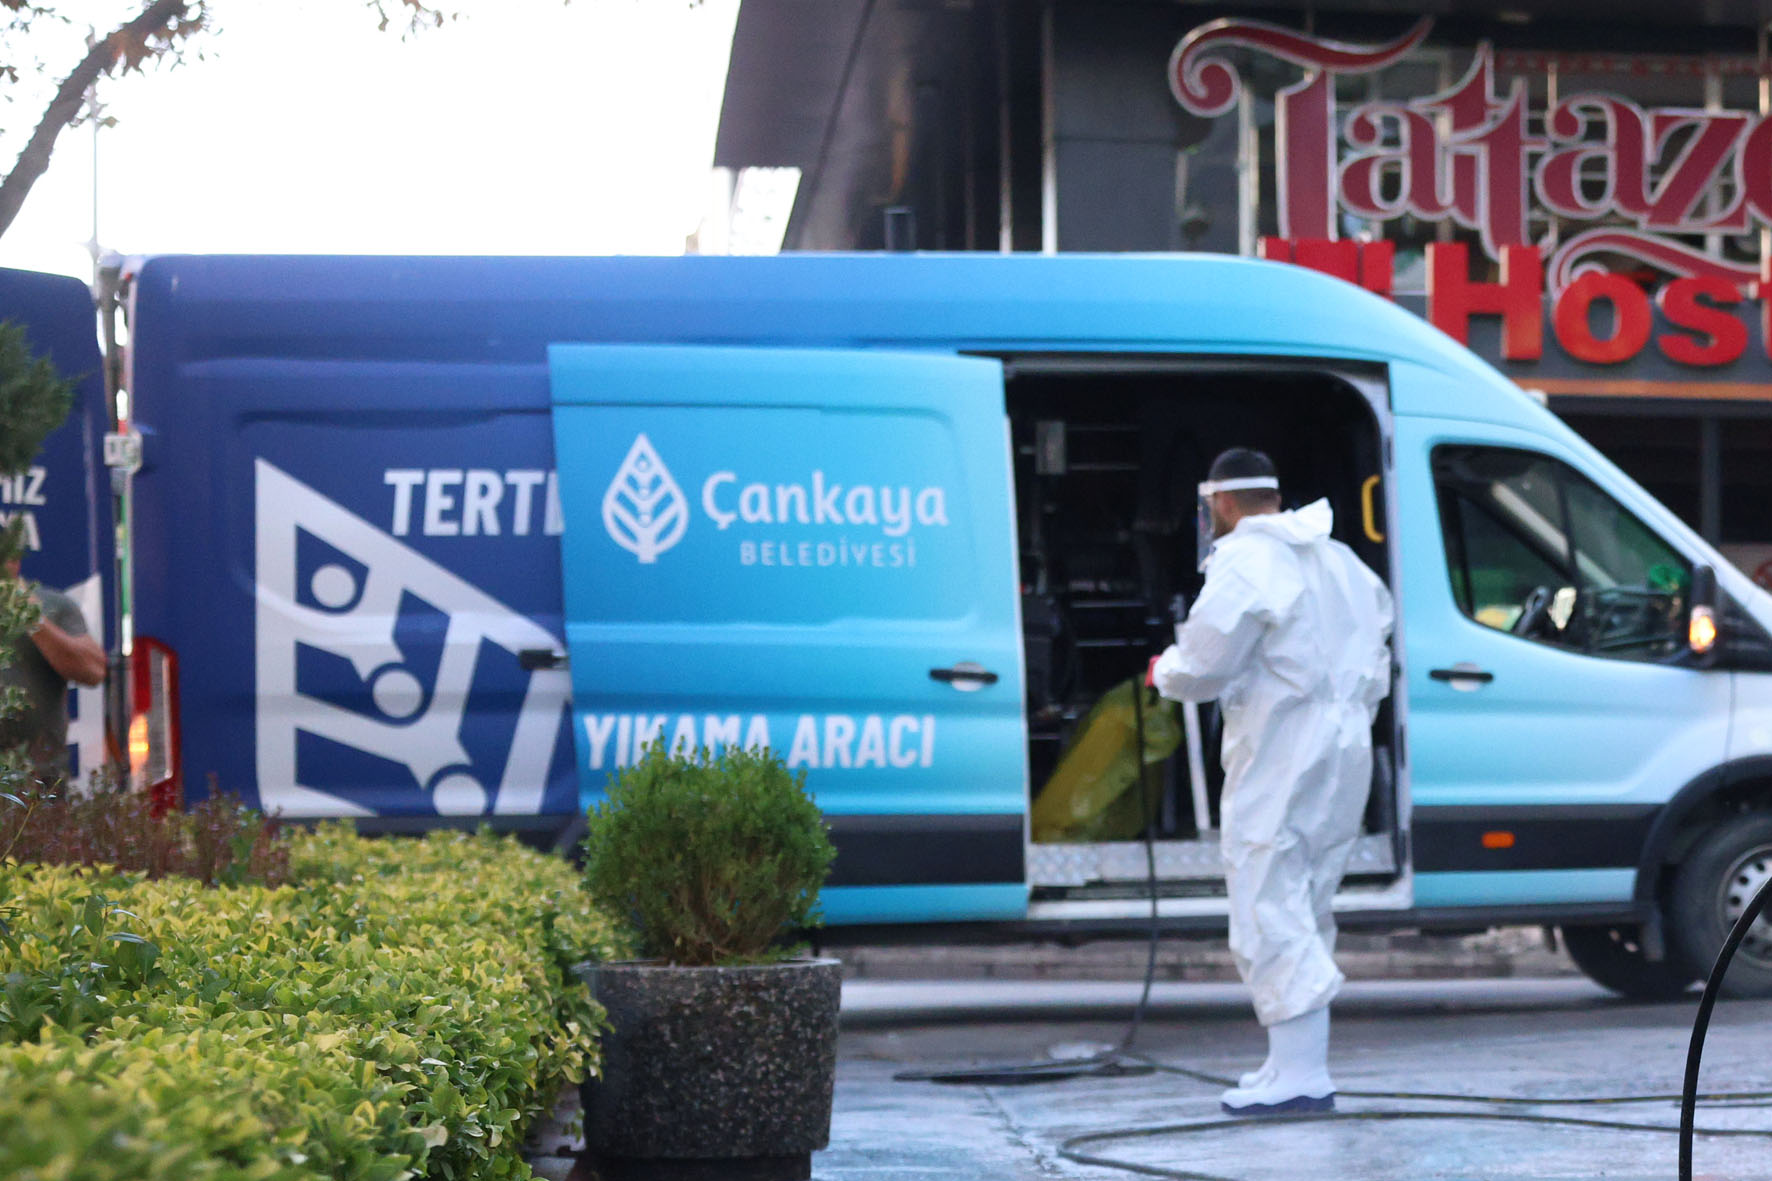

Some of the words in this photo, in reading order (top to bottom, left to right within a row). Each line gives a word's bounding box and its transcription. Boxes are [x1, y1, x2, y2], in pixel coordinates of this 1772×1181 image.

[701, 470, 949, 537] Çankaya
[740, 537, 917, 567] BELEDİYESİ
[583, 713, 771, 769] YIKAMA
[786, 713, 936, 770] ARACI
